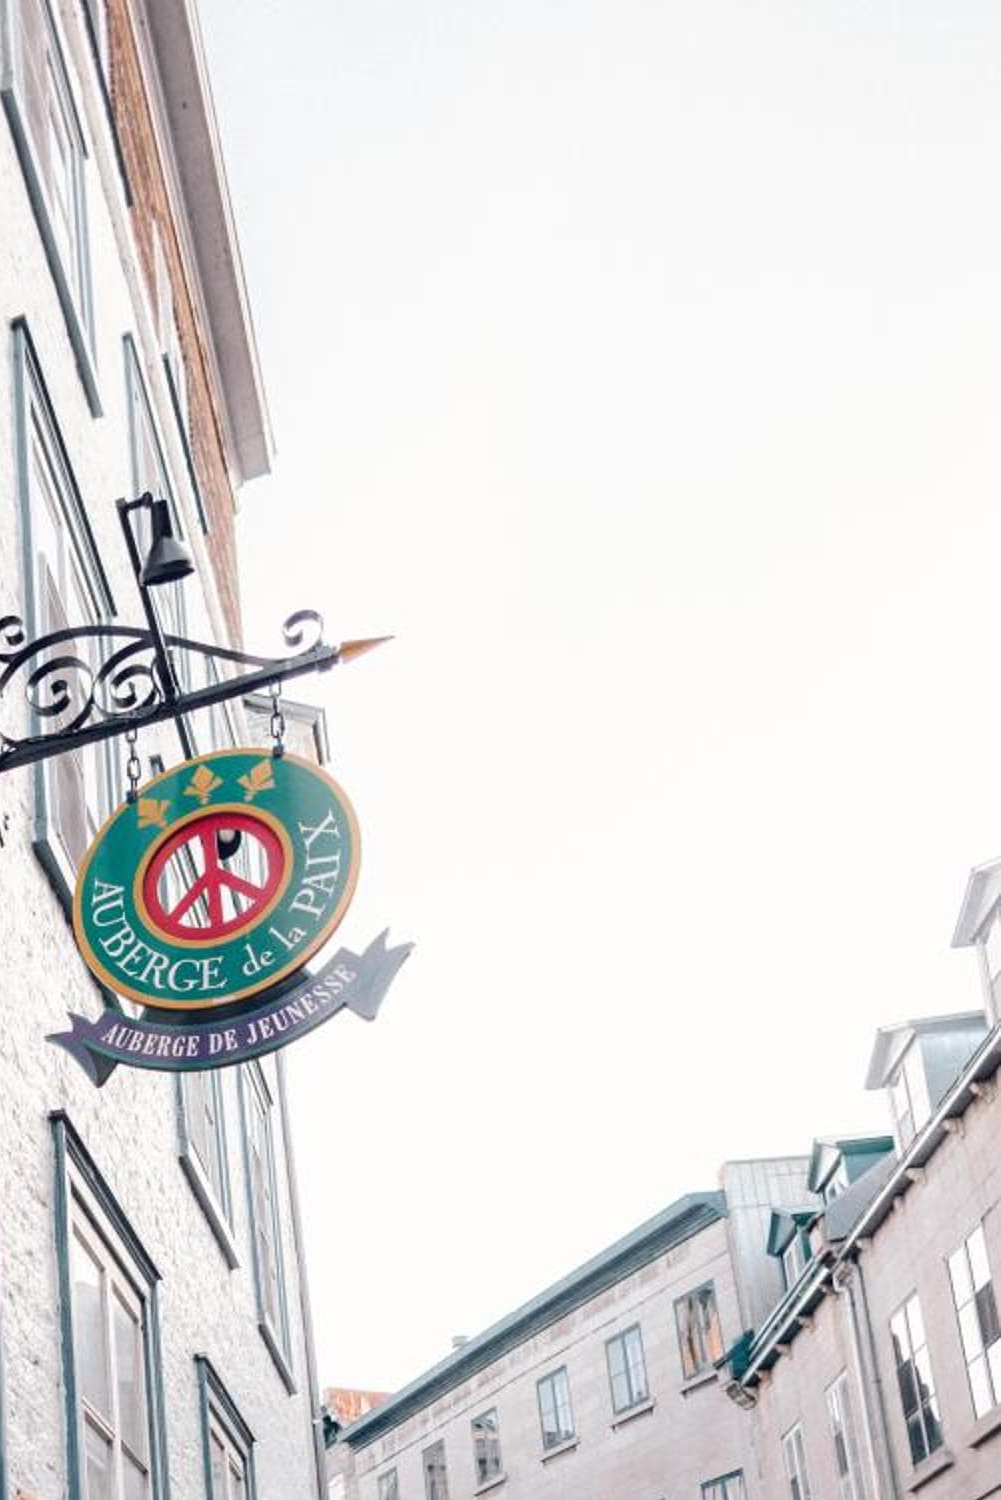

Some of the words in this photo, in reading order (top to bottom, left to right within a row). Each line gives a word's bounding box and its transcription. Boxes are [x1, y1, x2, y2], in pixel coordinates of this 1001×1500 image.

[91, 879, 228, 992] AUBERGE
[242, 943, 275, 977] de
[269, 926, 308, 951] la
[290, 809, 342, 921] PAIX
[101, 1022, 199, 1058] AUBERGE
[208, 1029, 238, 1055] DE
[246, 962, 358, 1044] JEUNESSE
